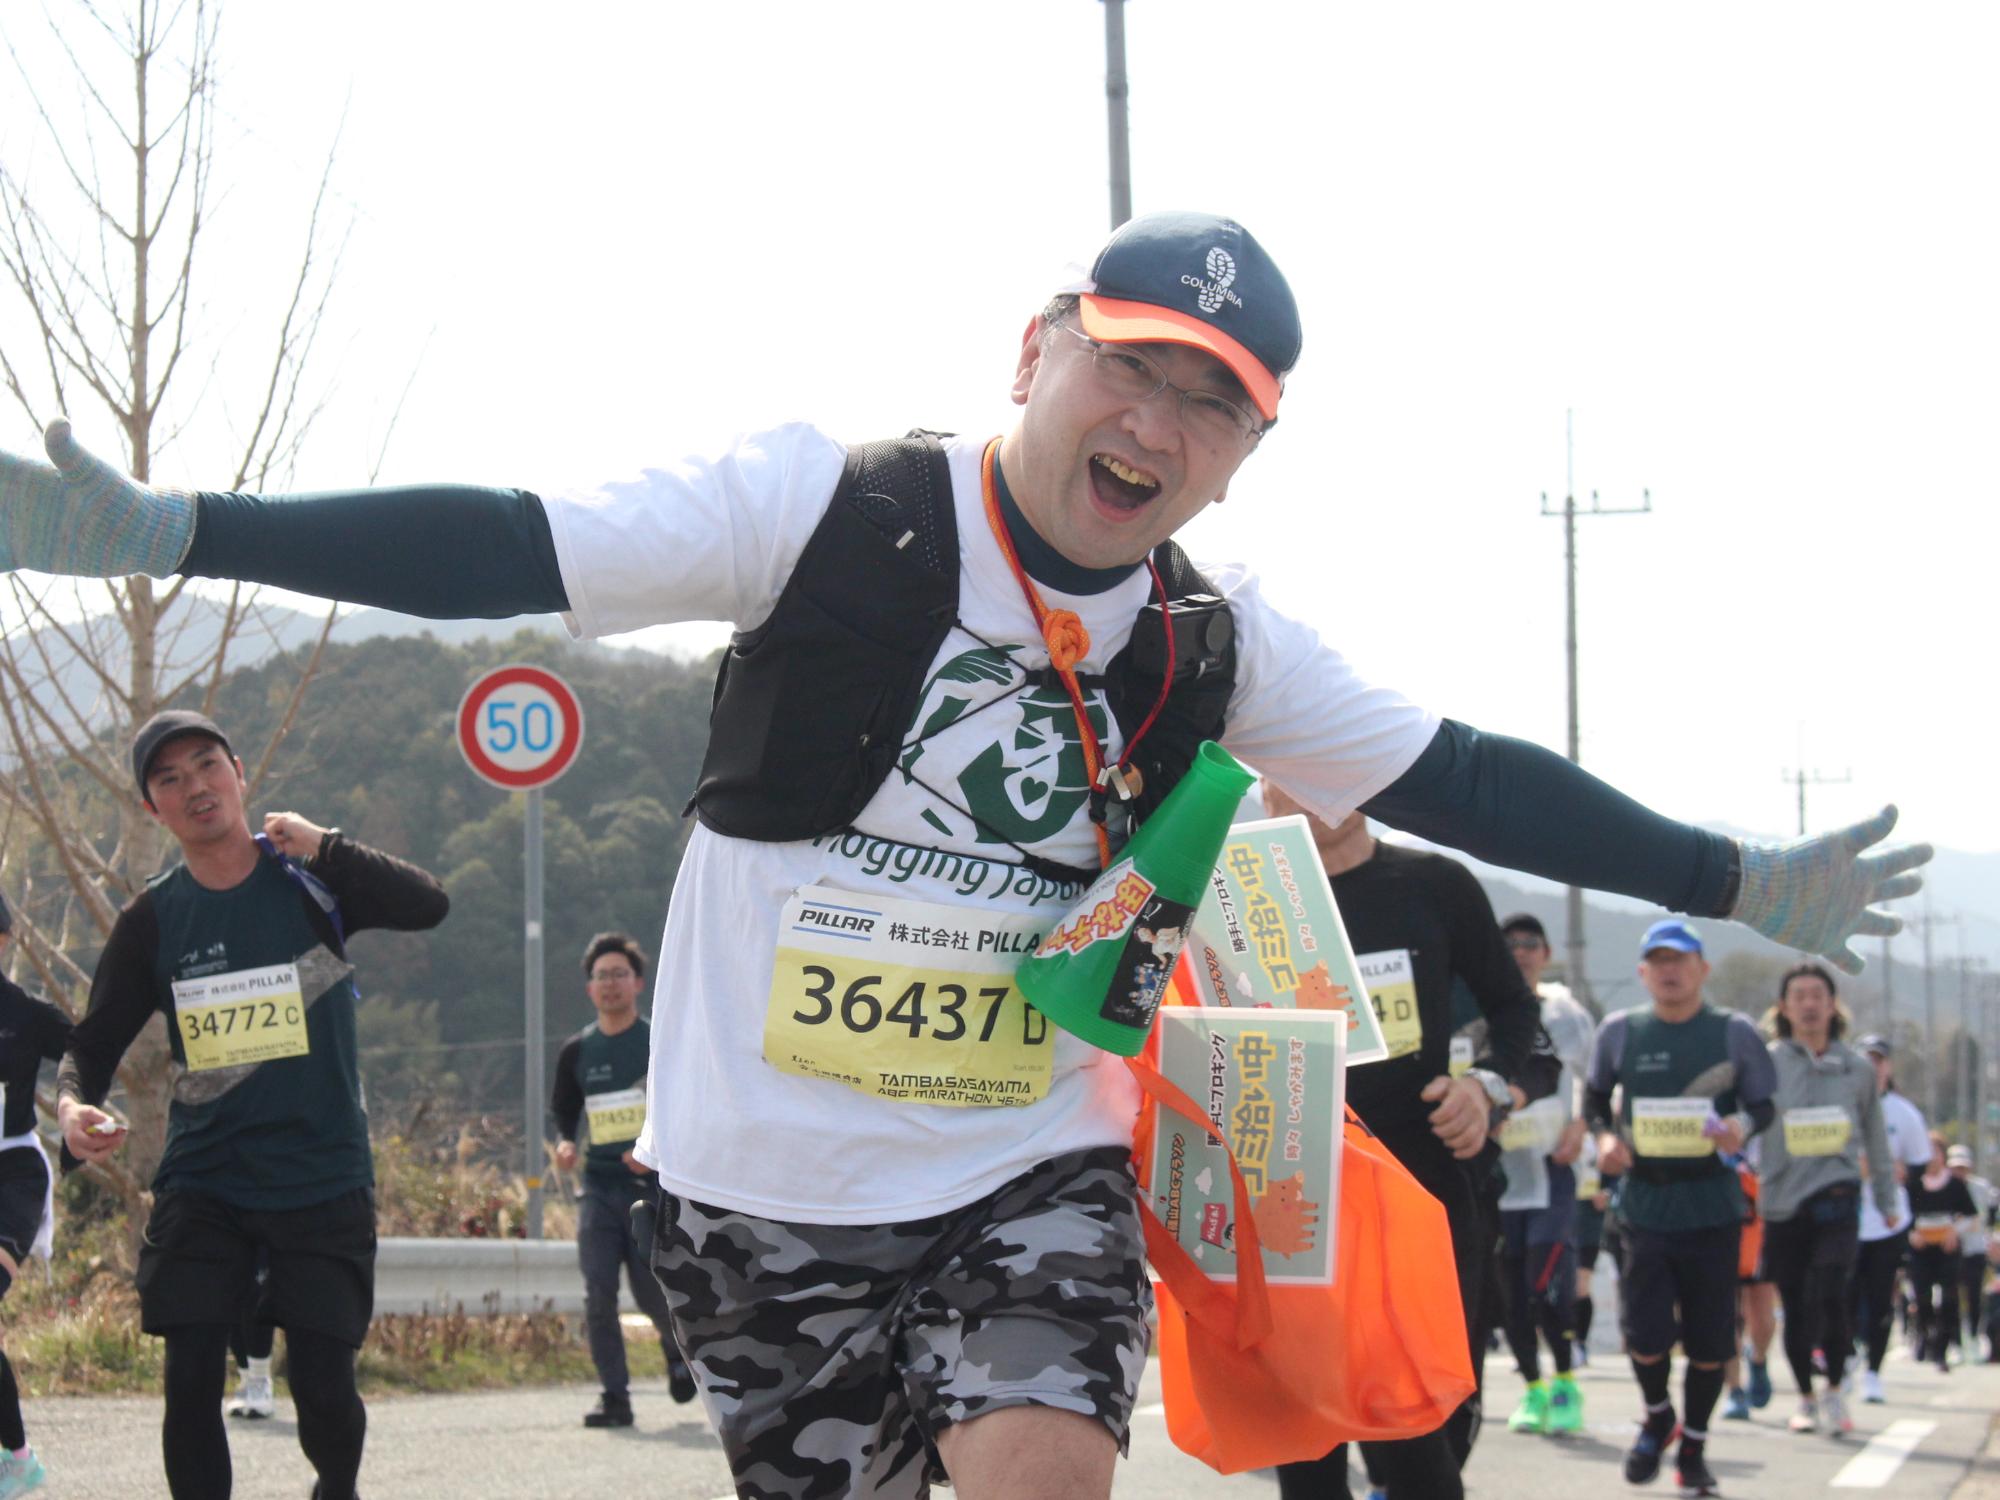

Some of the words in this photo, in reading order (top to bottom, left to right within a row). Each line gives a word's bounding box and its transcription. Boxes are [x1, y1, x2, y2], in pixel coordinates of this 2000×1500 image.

[1180, 274, 1243, 309] COLUMBIA
[487, 702, 553, 753] 50
[1270, 843, 1306, 919] しゃがみます
[798, 909, 875, 933] PILLAR
[1213, 866, 1248, 954] 勝手にプロギン
[1228, 846, 1300, 992] ゴミ拾い中
[888, 922, 970, 951] 株式会社
[976, 930, 1041, 953] PILLA
[1298, 924, 1318, 952] 時々
[248, 973, 293, 990] PILLAR
[1203, 946, 1232, 1008] BCマラソン
[184, 1002, 279, 1041] 34772
[285, 1006, 300, 1025] C
[792, 965, 1010, 1042] 36437
[1023, 1002, 1047, 1045] D
[1394, 999, 1411, 1021] D
[878, 1087, 909, 1098] ABC
[914, 1089, 993, 1104] MARATHON
[879, 1073, 1031, 1094] TAMBASASAYAMA
[1288, 1037, 1305, 1123] しゃがみます
[1231, 1031, 1277, 1197] ゴミ拾い中
[1285, 1130, 1303, 1160] 時々
[1165, 1133, 1185, 1241] 篠山ABCマラソン
